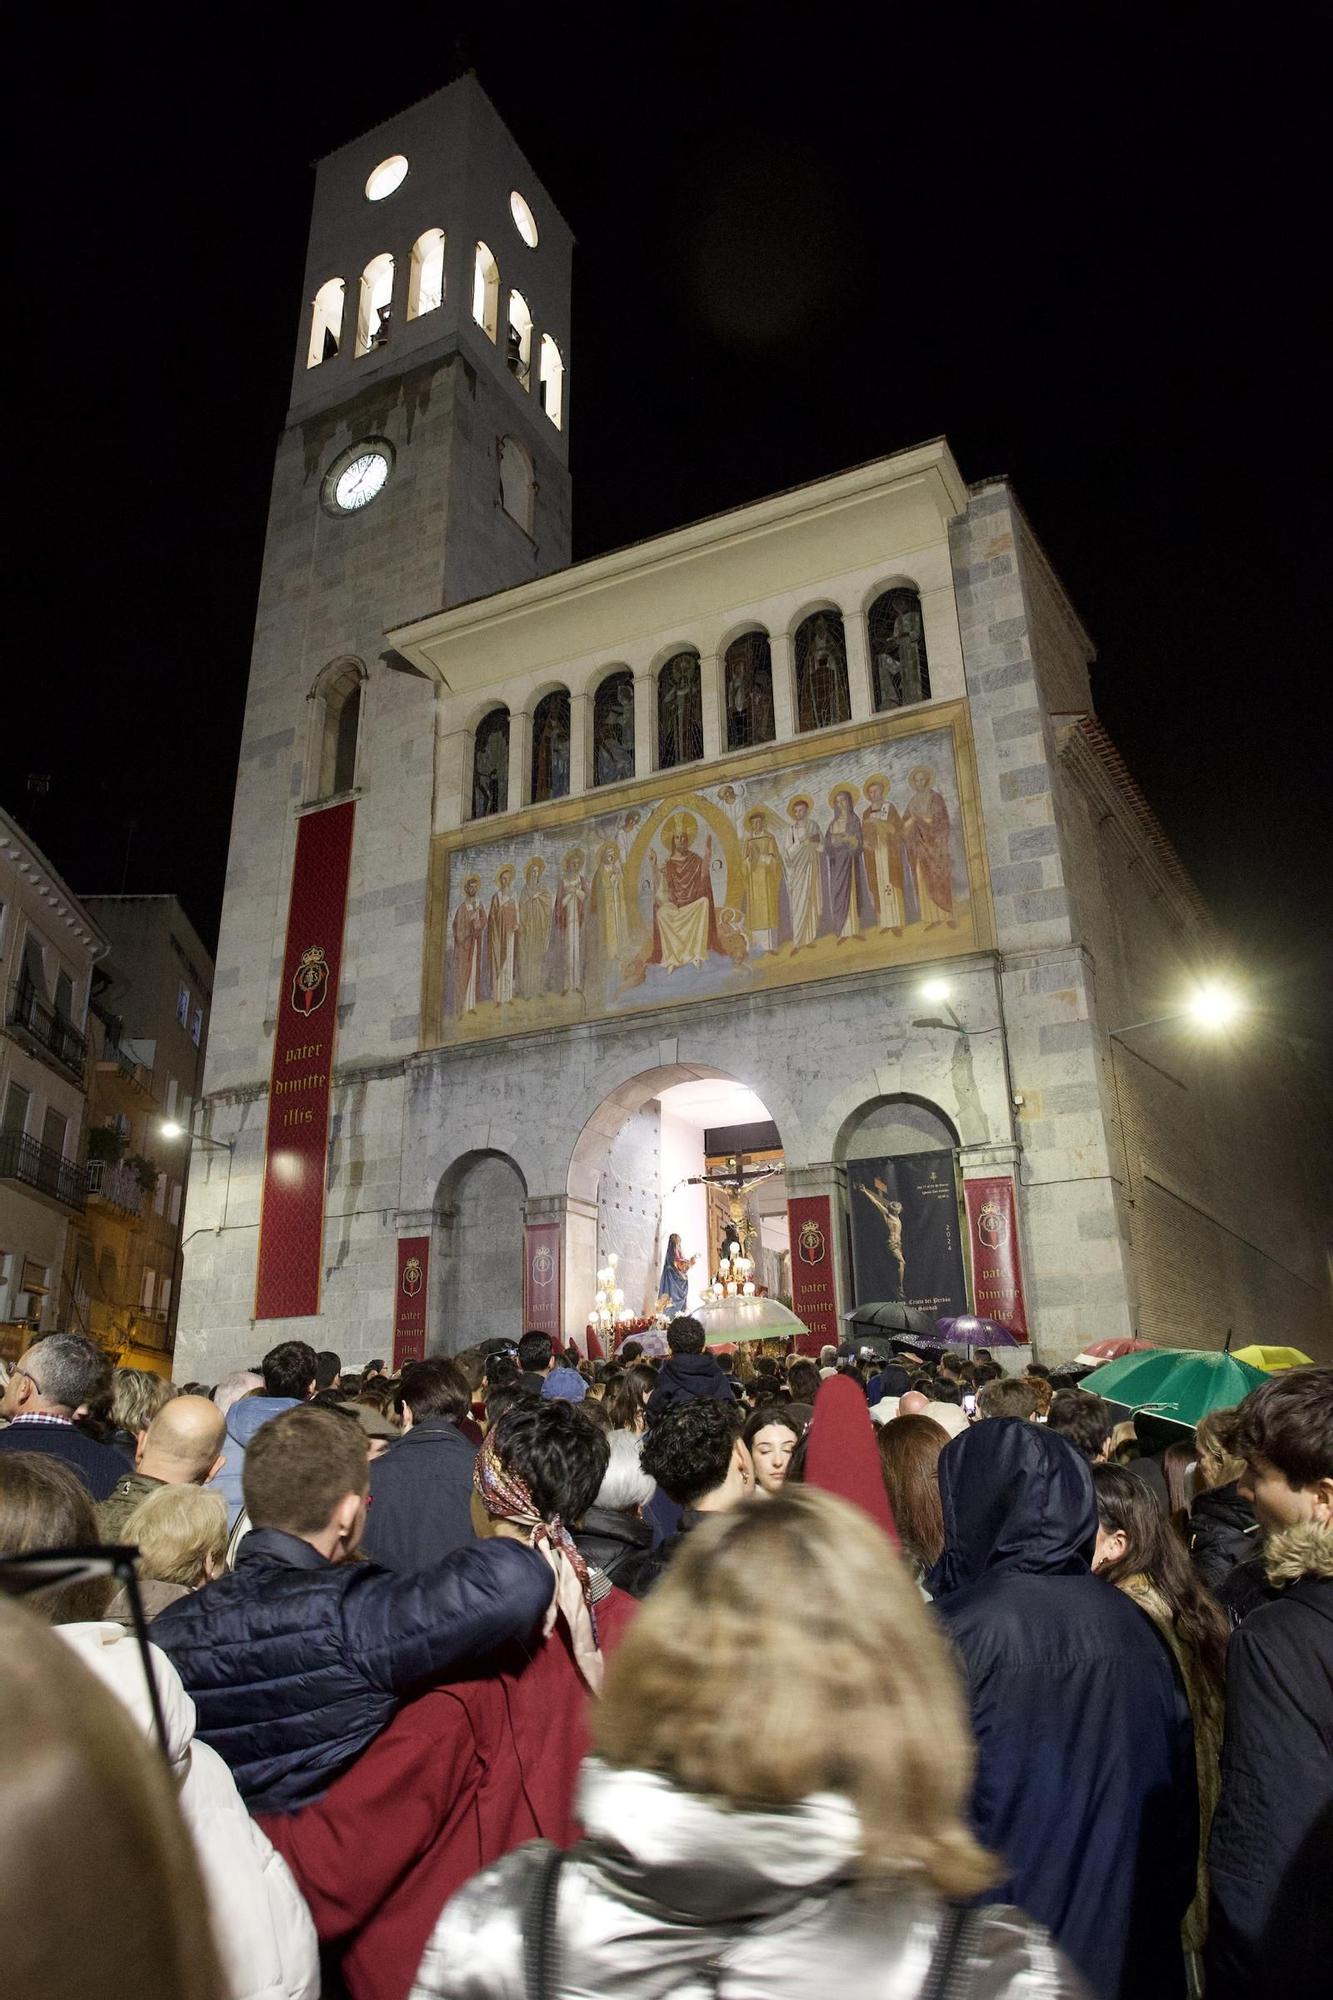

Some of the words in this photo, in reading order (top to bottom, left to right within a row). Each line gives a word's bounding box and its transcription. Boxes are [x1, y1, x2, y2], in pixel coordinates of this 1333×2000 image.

[285, 1044, 323, 1065] pater
[275, 1074, 326, 1095] dimitte
[283, 1107, 313, 1127] illis
[801, 1282, 827, 1295] pater
[797, 1301, 834, 1312] dimitte
[401, 1311, 421, 1321] pater
[396, 1328, 424, 1337] dimitte
[807, 1321, 827, 1333] llis
